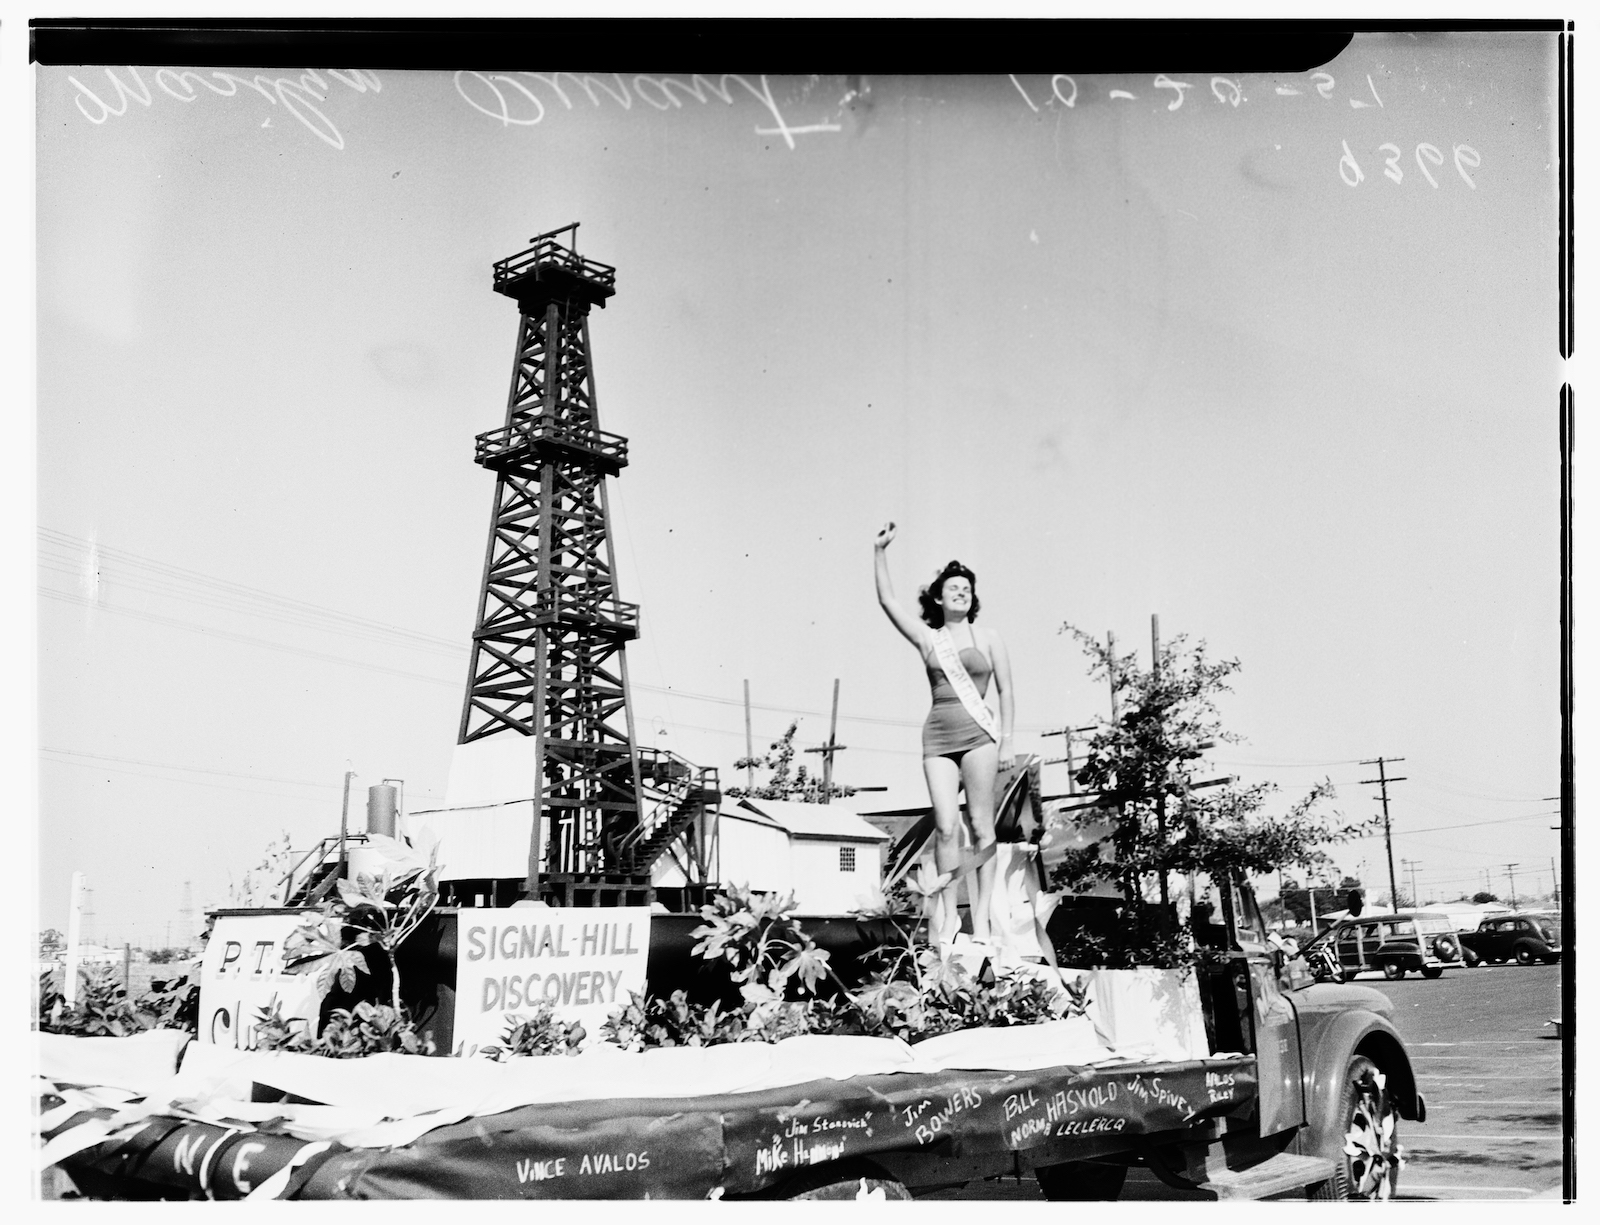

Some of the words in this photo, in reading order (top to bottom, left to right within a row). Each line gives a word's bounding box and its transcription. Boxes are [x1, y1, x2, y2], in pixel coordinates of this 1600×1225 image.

[481, 970, 623, 1014] DISCOVERY
[915, 1086, 982, 1145] BOWERS
[1046, 1081, 1118, 1122] HASVOLD
[579, 1151, 651, 1175] AVALOS
